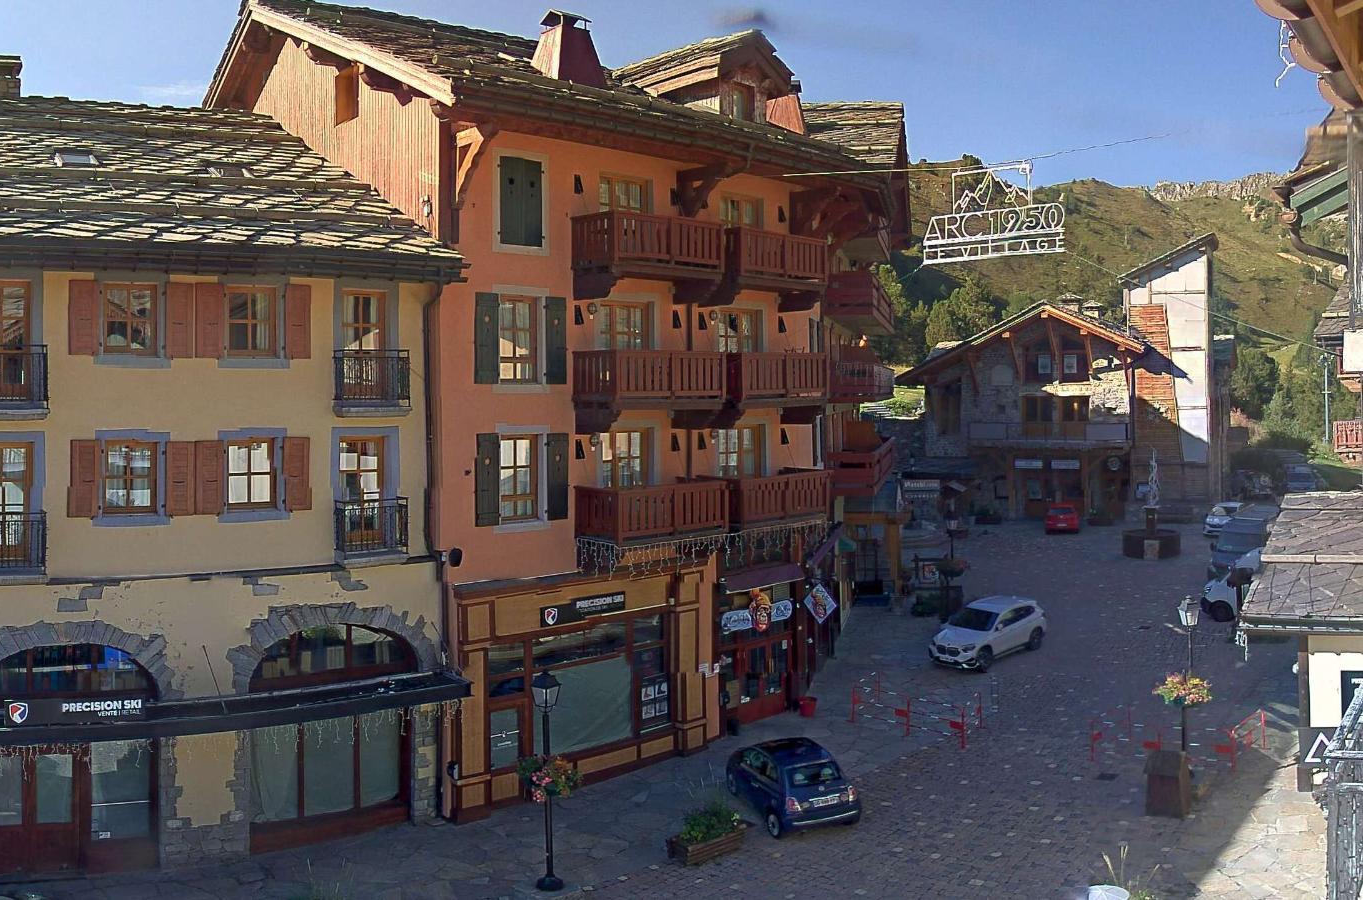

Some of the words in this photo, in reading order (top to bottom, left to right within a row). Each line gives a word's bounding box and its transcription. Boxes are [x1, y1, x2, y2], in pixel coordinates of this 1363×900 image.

[924, 214, 983, 242] ARC
[988, 203, 1065, 237] 1950
[576, 597, 612, 608] PRECISION
[62, 700, 122, 713] PRECISION
[124, 699, 142, 710] SKI
